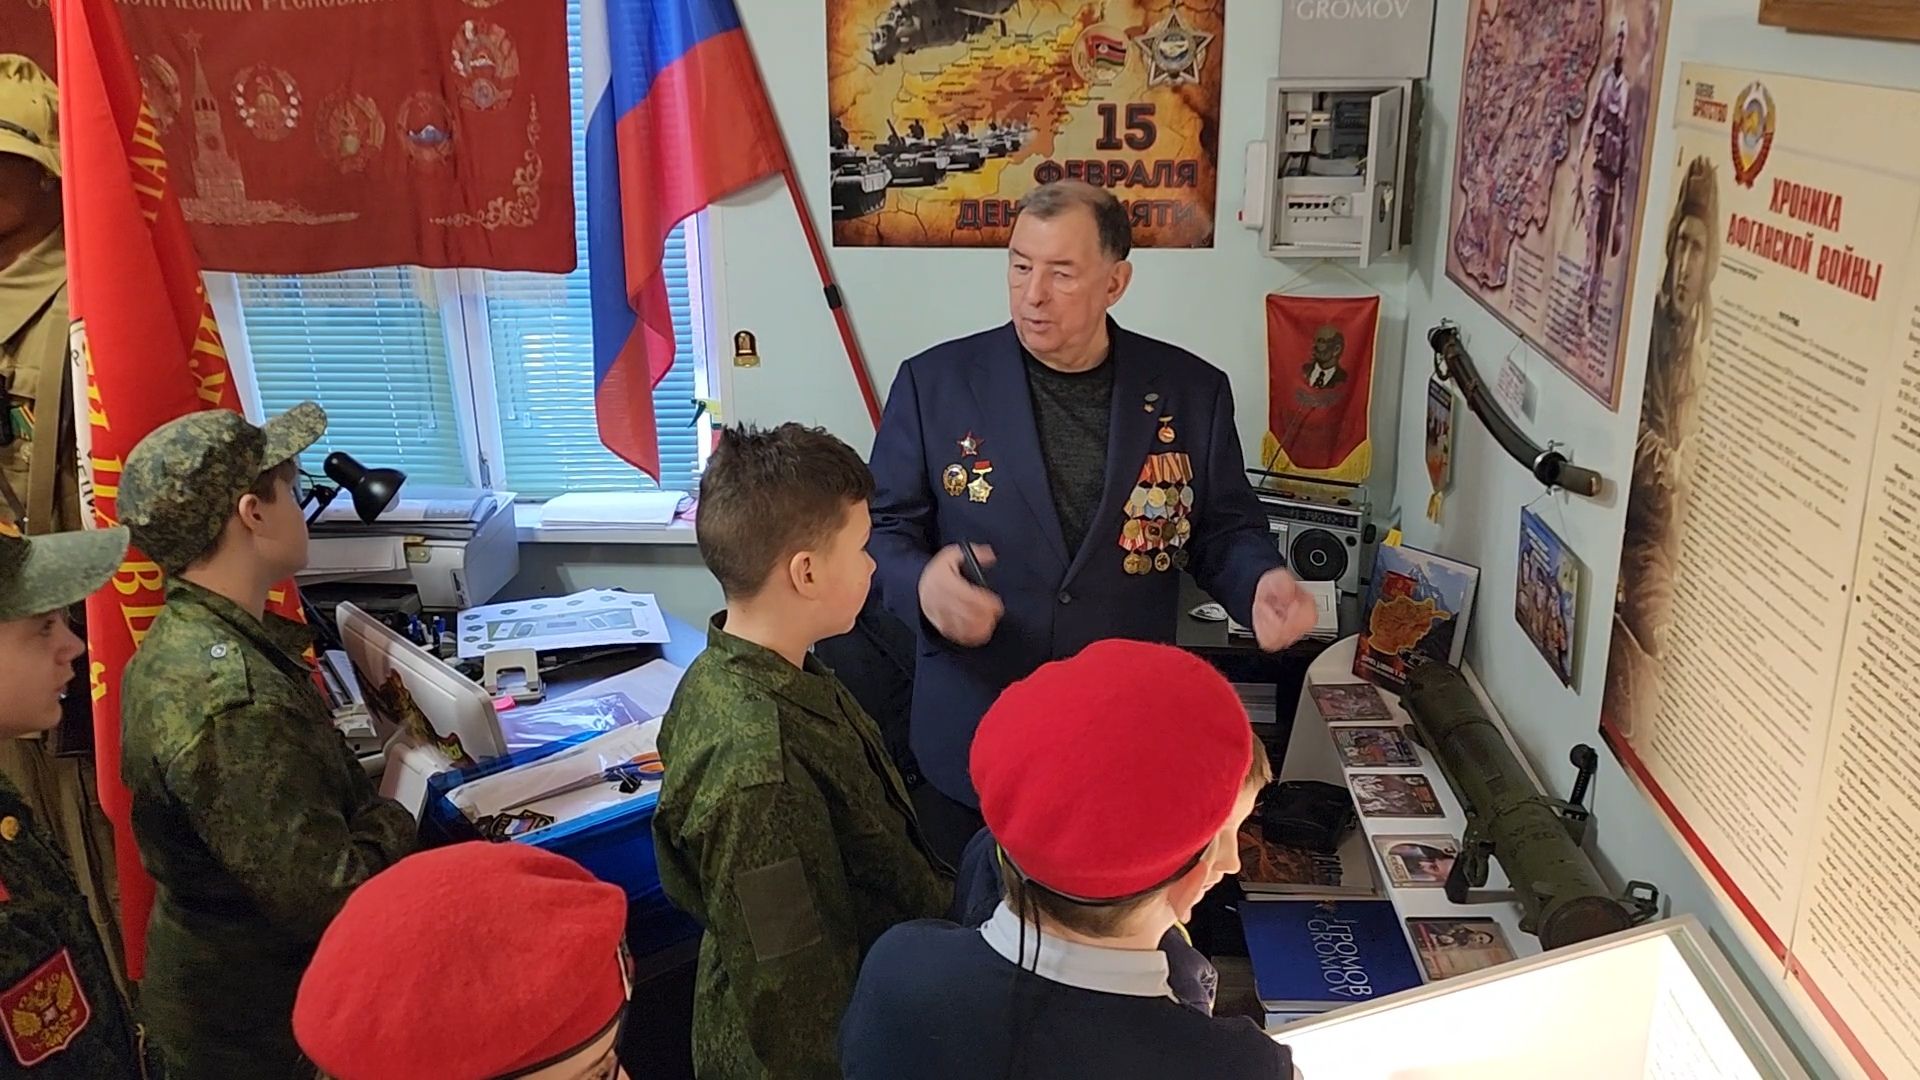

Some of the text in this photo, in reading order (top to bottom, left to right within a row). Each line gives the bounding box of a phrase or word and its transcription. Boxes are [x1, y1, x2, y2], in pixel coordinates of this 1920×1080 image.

[1297, 0, 1409, 19] GROMOV
[1096, 103, 1157, 151] 15
[1033, 160, 1198, 188] ФЕВРАЛЯ
[956, 199, 1021, 229] ДЕН
[1769, 178, 1842, 232] ХРОНИКА
[1727, 213, 1883, 301] АФГАНСКОЙ ВОЙНЫ
[1307, 919, 1352, 996] GROMOV
